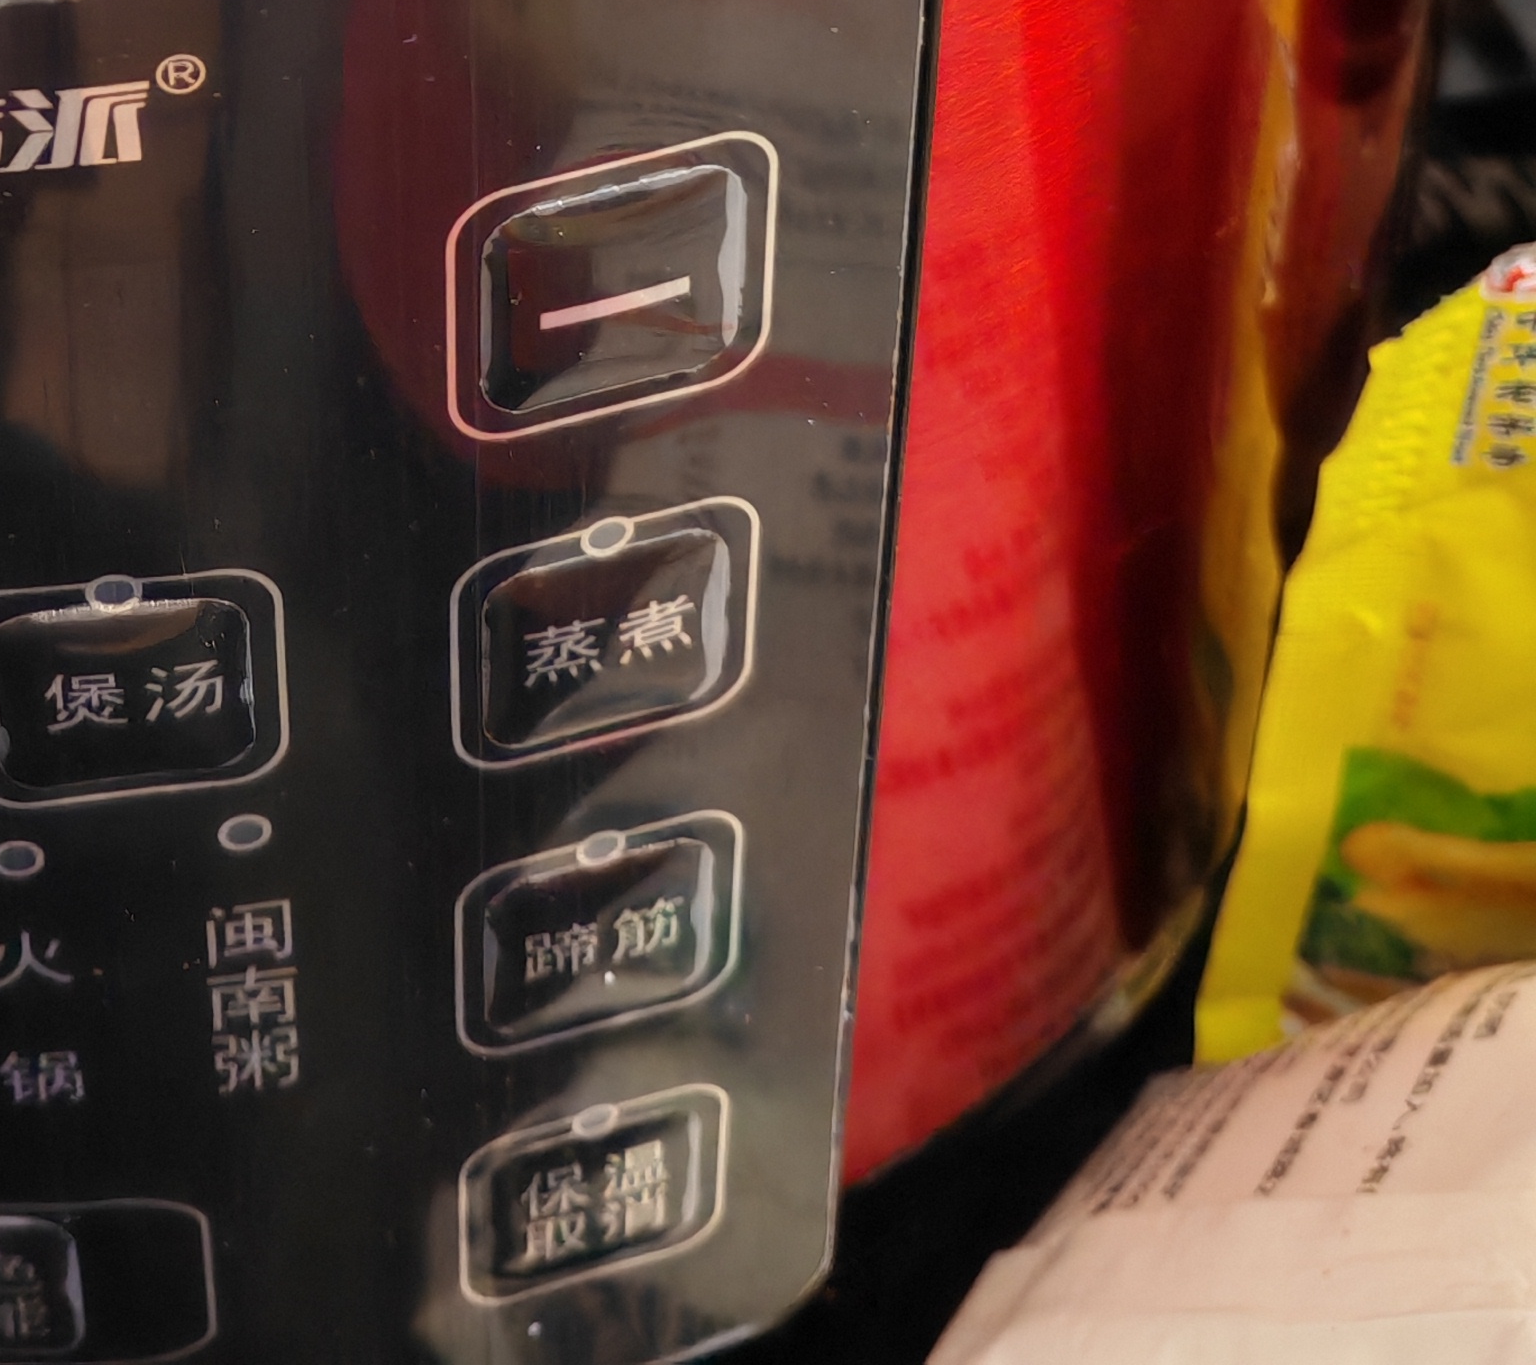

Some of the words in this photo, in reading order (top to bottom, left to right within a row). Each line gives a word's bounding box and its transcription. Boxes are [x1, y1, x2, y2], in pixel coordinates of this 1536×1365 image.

[523, 594, 696, 688] 蒸煮
[45, 660, 227, 734] 煲汤
[523, 895, 685, 984] 蹄筋
[205, 897, 300, 1095] 闽南粥
[519, 1138, 670, 1219] 保温
